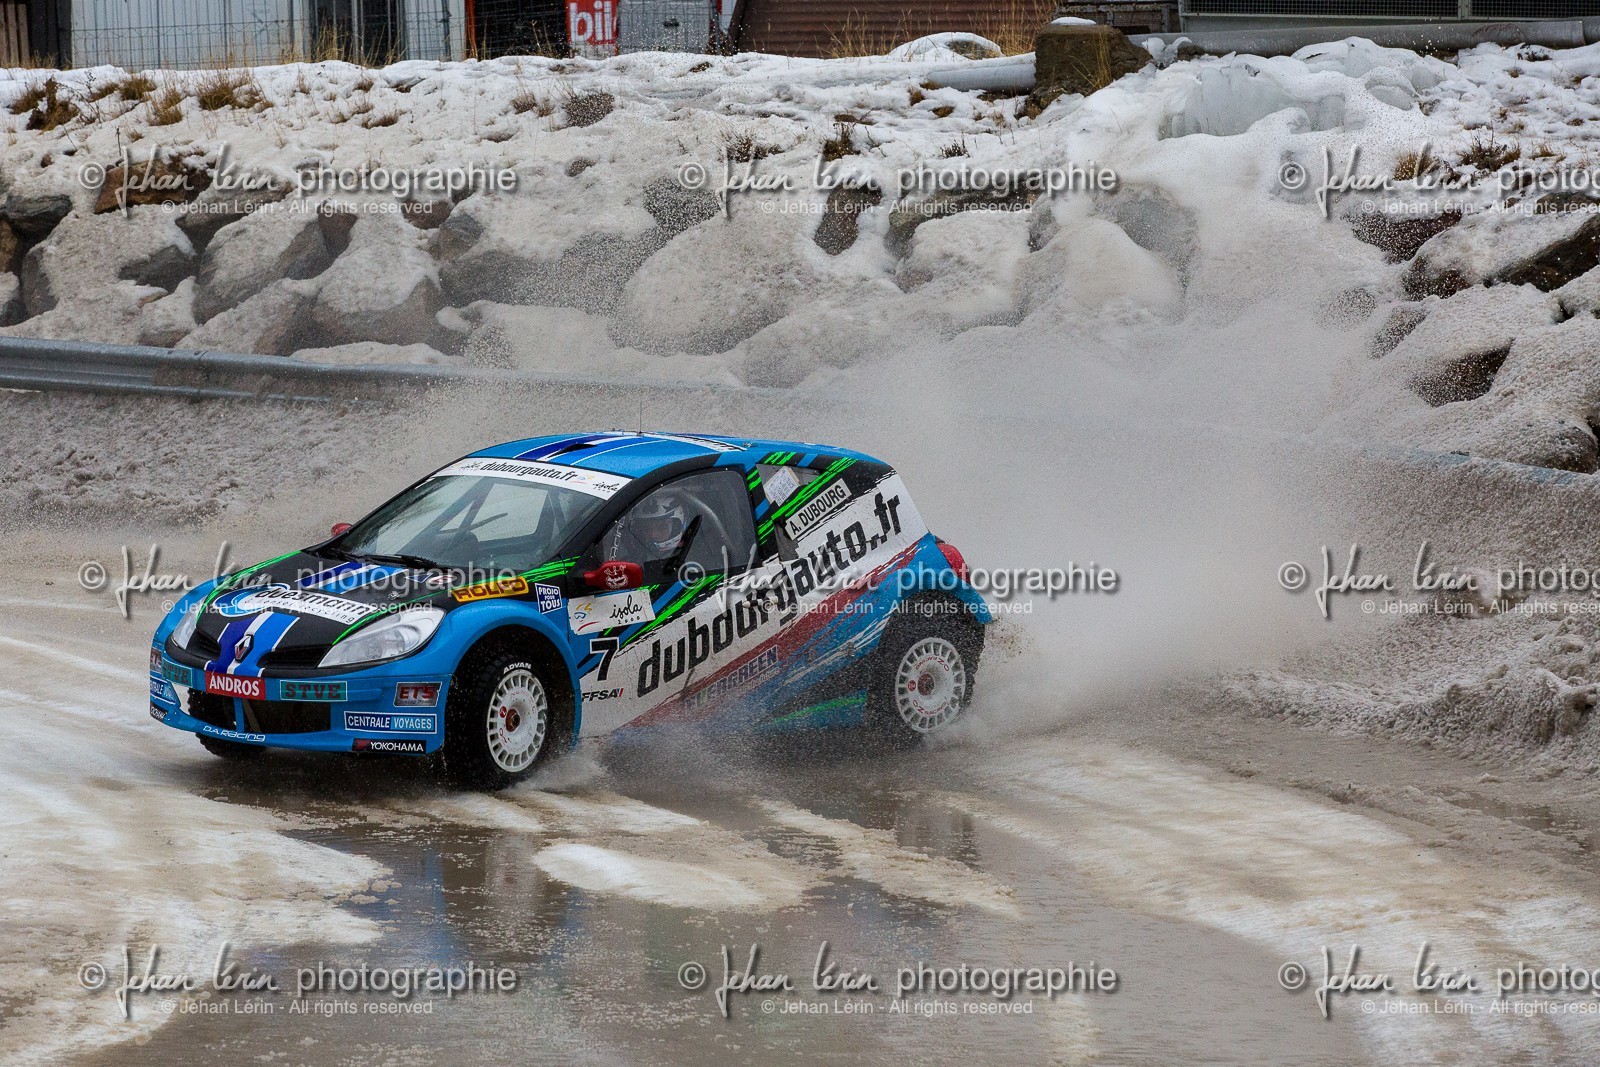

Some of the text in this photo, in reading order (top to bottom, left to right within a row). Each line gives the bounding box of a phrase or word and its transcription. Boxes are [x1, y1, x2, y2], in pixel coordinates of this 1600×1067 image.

[569, 0, 617, 44] bil
[480, 461, 579, 482] dubourgauto.fr
[790, 515, 804, 535] A.
[800, 484, 847, 528] DUBOURG
[457, 579, 526, 600] ROLFO
[637, 491, 902, 698] dubourgauto.fr
[254, 587, 371, 616] duesmann
[540, 599, 561, 611] TOUS
[609, 594, 643, 620] isola
[503, 661, 532, 675] ADVAN
[590, 637, 619, 682] 7
[209, 676, 260, 697] ANDROS
[285, 683, 341, 699] STVE
[581, 688, 618, 702] FFSA
[347, 715, 432, 729] CENTRALE VOYAGES
[370, 741, 424, 752] YOKOHAMA
